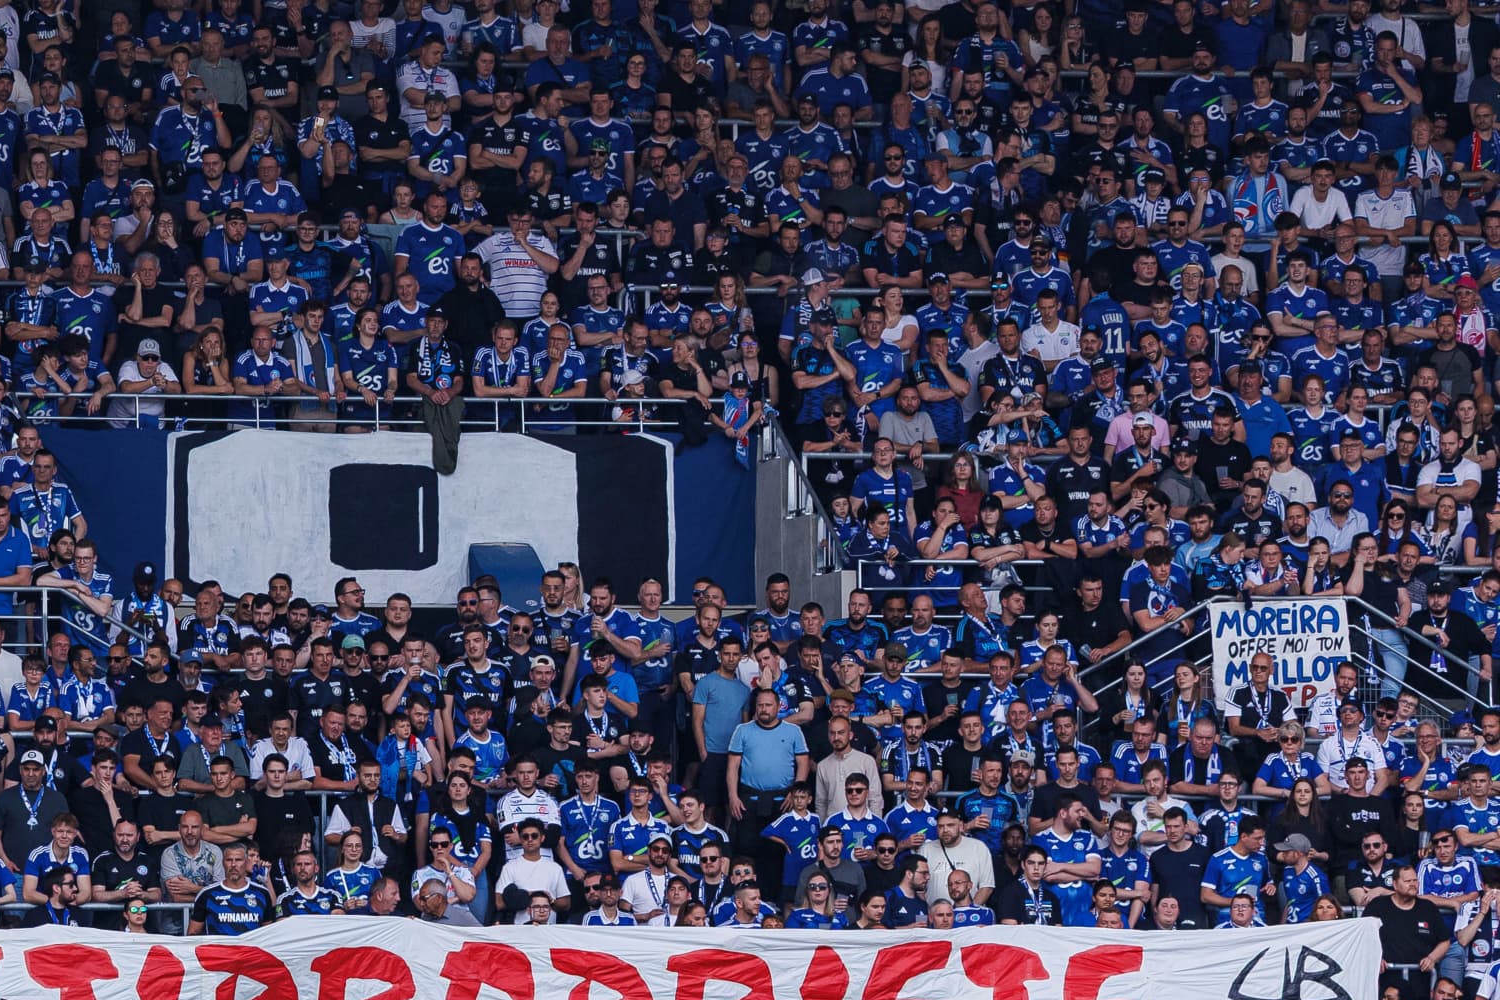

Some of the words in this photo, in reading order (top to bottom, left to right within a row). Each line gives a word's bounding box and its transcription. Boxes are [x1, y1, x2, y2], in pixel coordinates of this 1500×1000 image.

[543, 136, 561, 151] es
[427, 158, 450, 175] es
[428, 257, 450, 275] es
[1103, 328, 1125, 353] 11
[1301, 444, 1322, 461] es
[1228, 638, 1276, 658] OFFRE
[1316, 636, 1344, 651] TON
[218, 911, 259, 923] WINAMAX
